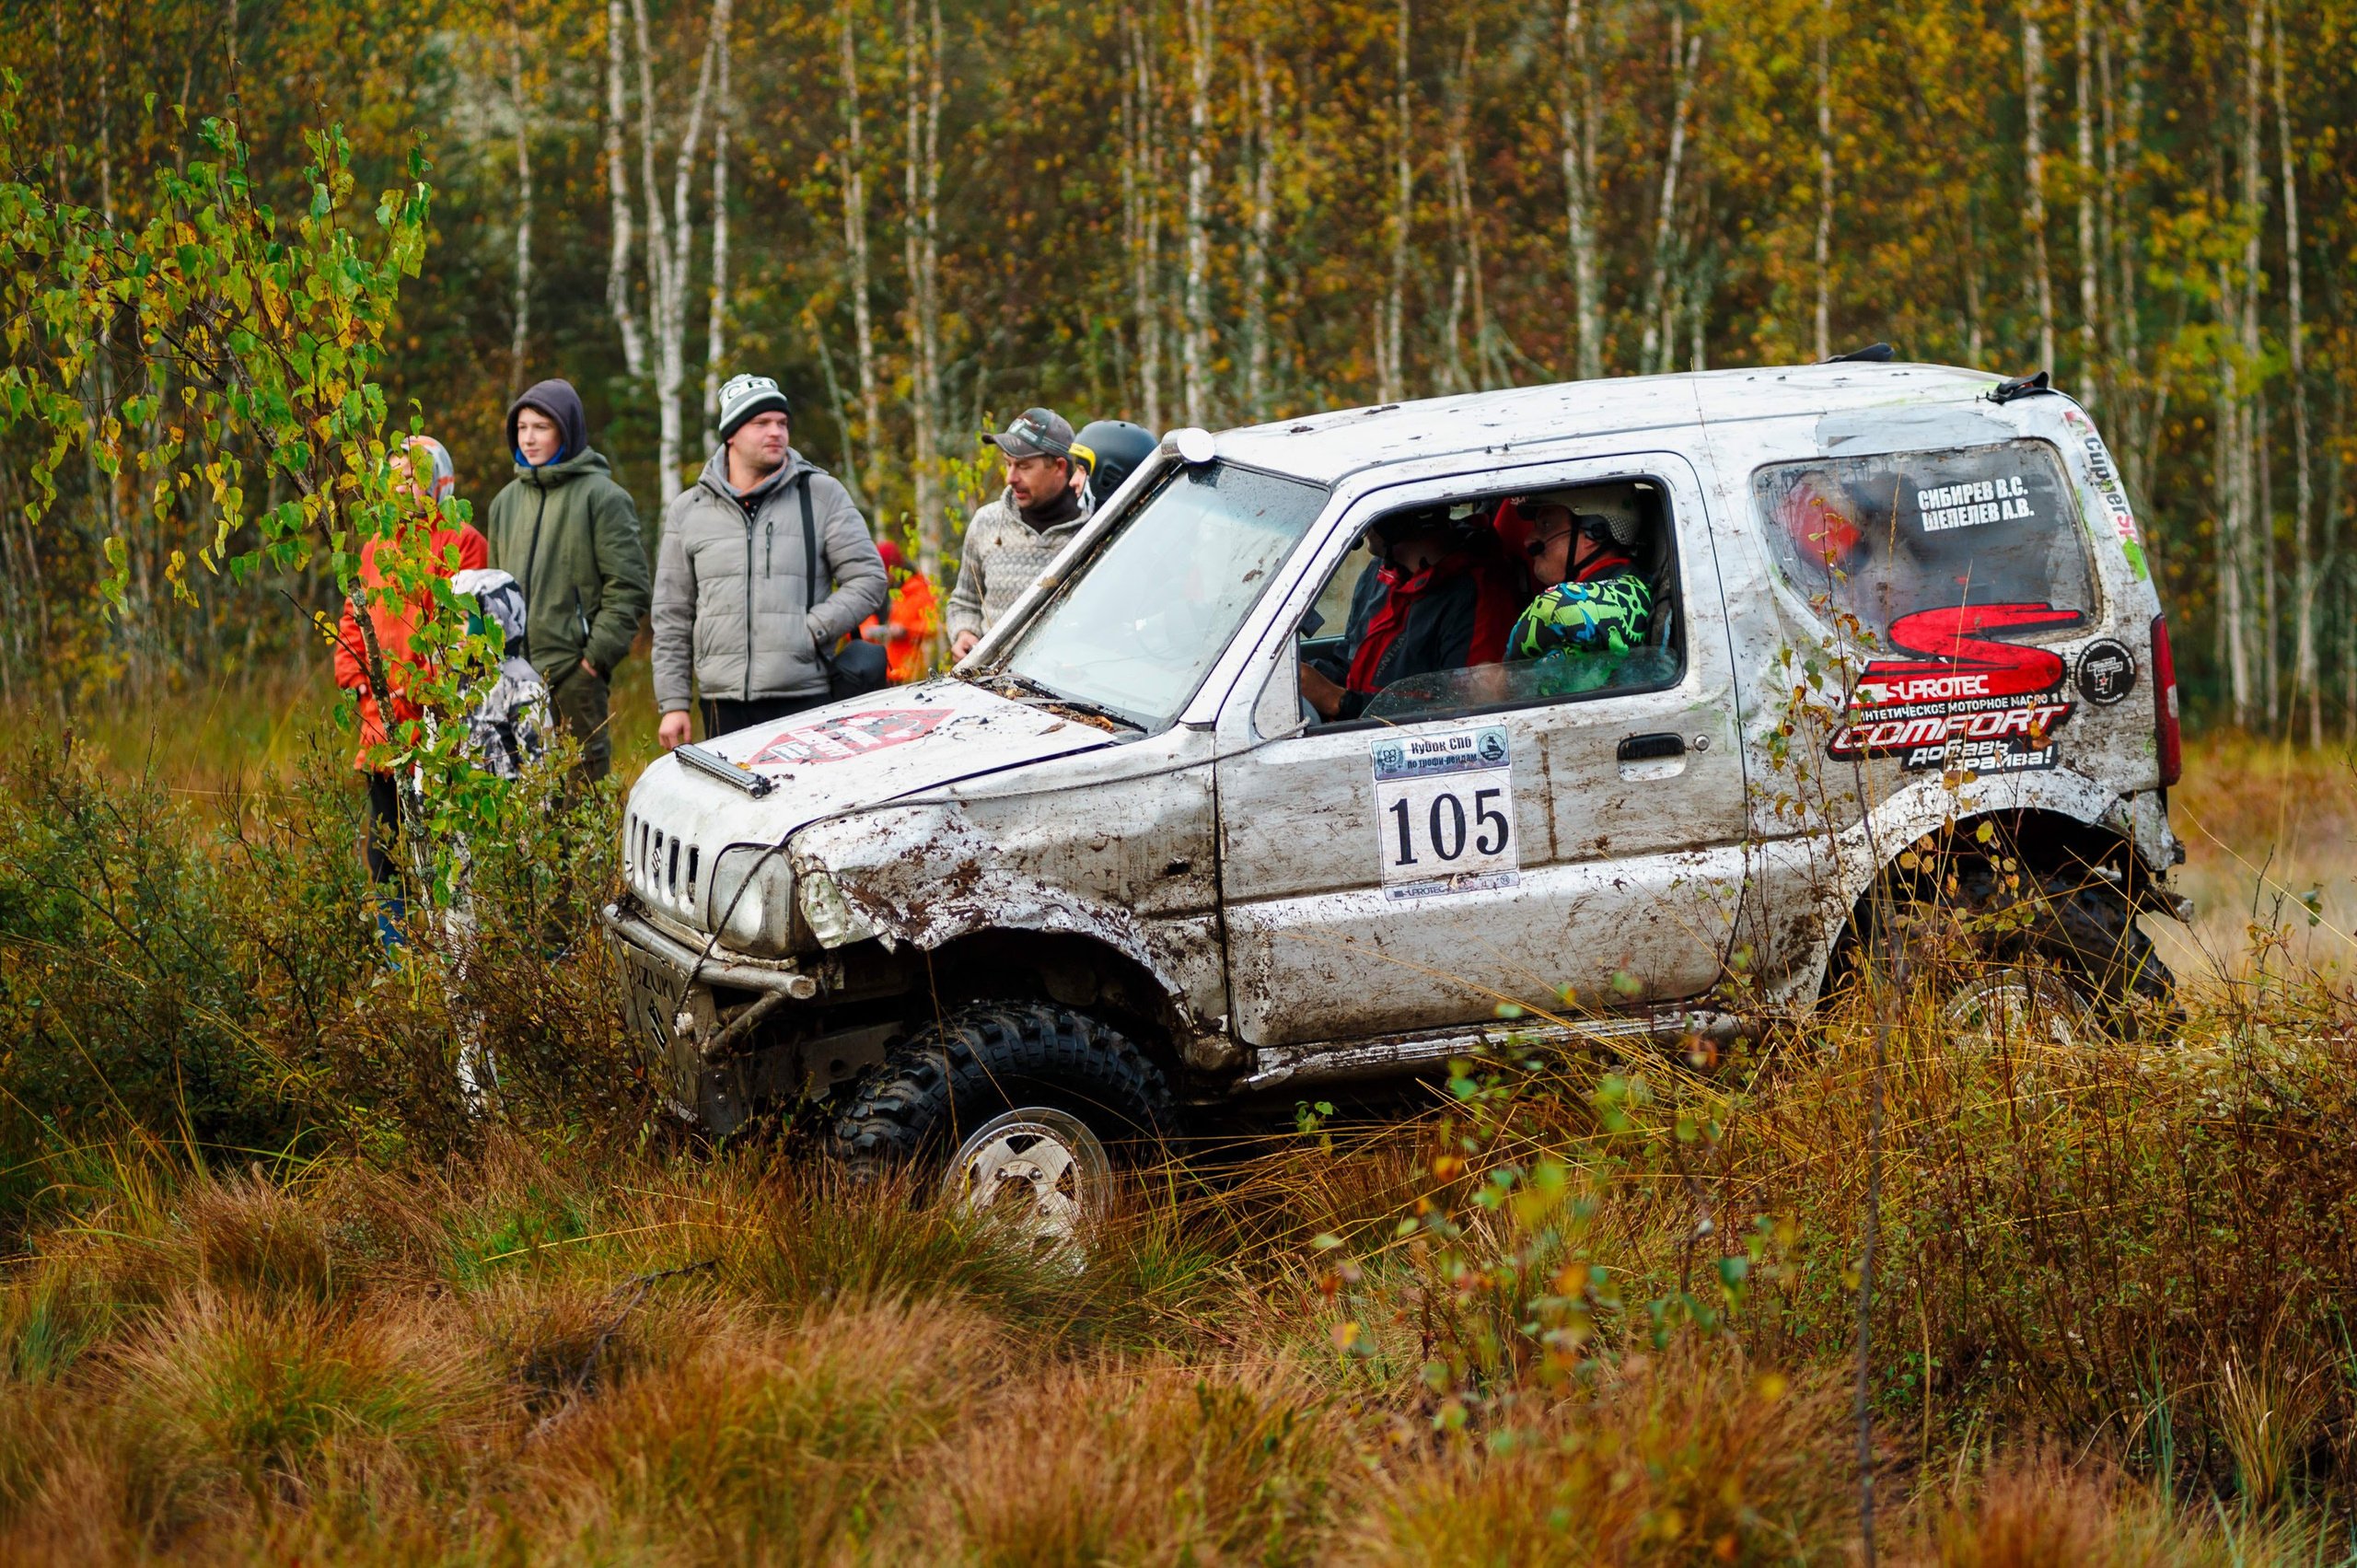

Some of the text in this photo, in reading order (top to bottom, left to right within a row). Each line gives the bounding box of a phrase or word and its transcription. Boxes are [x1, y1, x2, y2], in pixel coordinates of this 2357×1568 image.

[1917, 476, 2028, 511] СИБИРЕВ В.С.
[1921, 498, 2035, 532] ШЕПЕЛЕВ А.В.
[1852, 703, 1945, 721] ИНТЕТИЧЕСКОЕ
[1948, 697, 2009, 713] МОТОРНОЕ
[1834, 705, 2065, 749] COMFORT
[1411, 737, 1472, 754] Кубок СПб
[1389, 788, 1509, 865] 105
